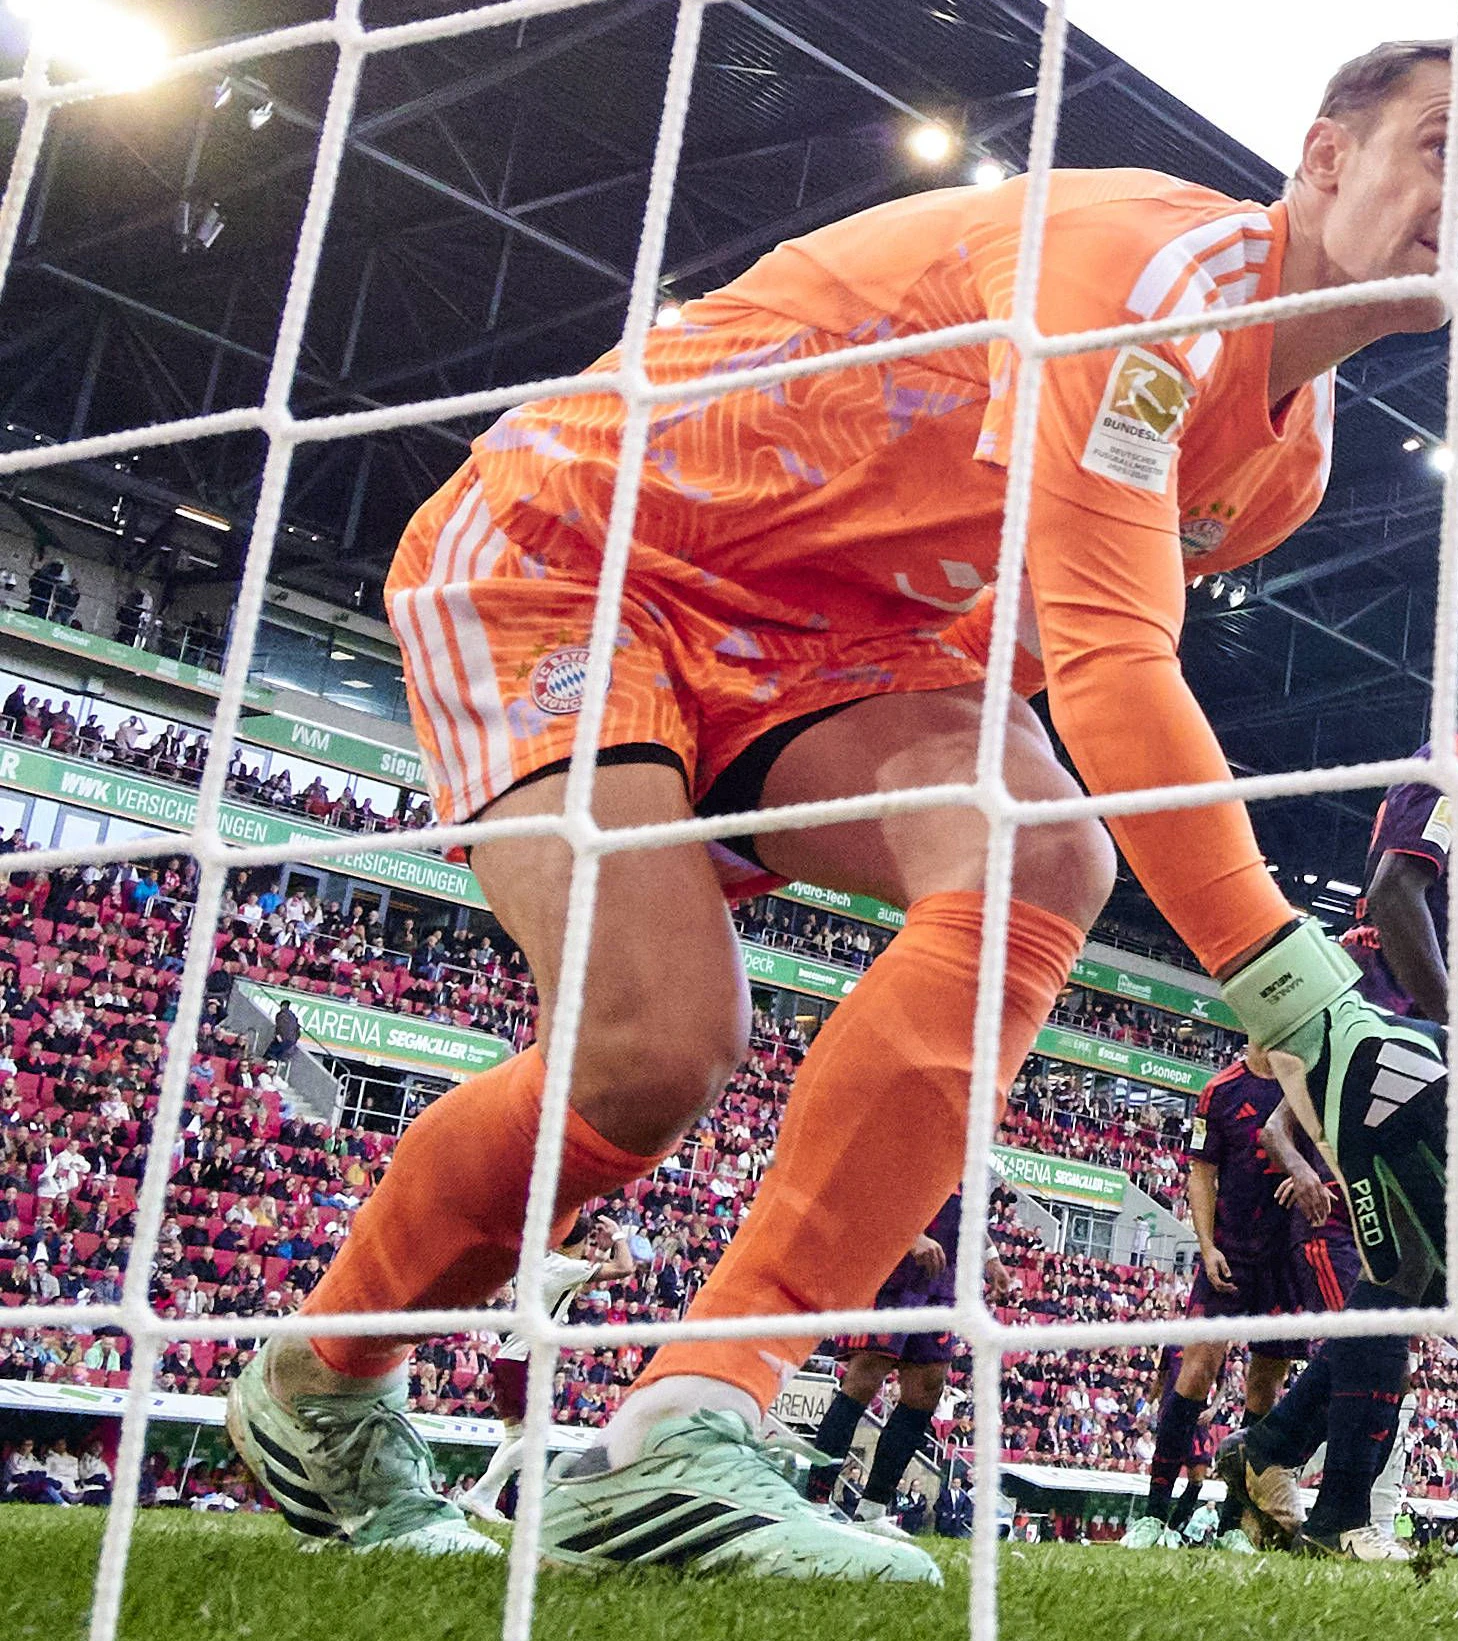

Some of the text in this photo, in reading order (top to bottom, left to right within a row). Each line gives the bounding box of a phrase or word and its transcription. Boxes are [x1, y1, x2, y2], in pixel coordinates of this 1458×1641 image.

[1103, 417, 1168, 444] BUNDESL
[61, 772, 268, 843] WWK VERSICHENGEN
[302, 1009, 382, 1048] ARENA
[1152, 1064, 1193, 1085] sonepar
[1351, 1178, 1385, 1247] PRED
